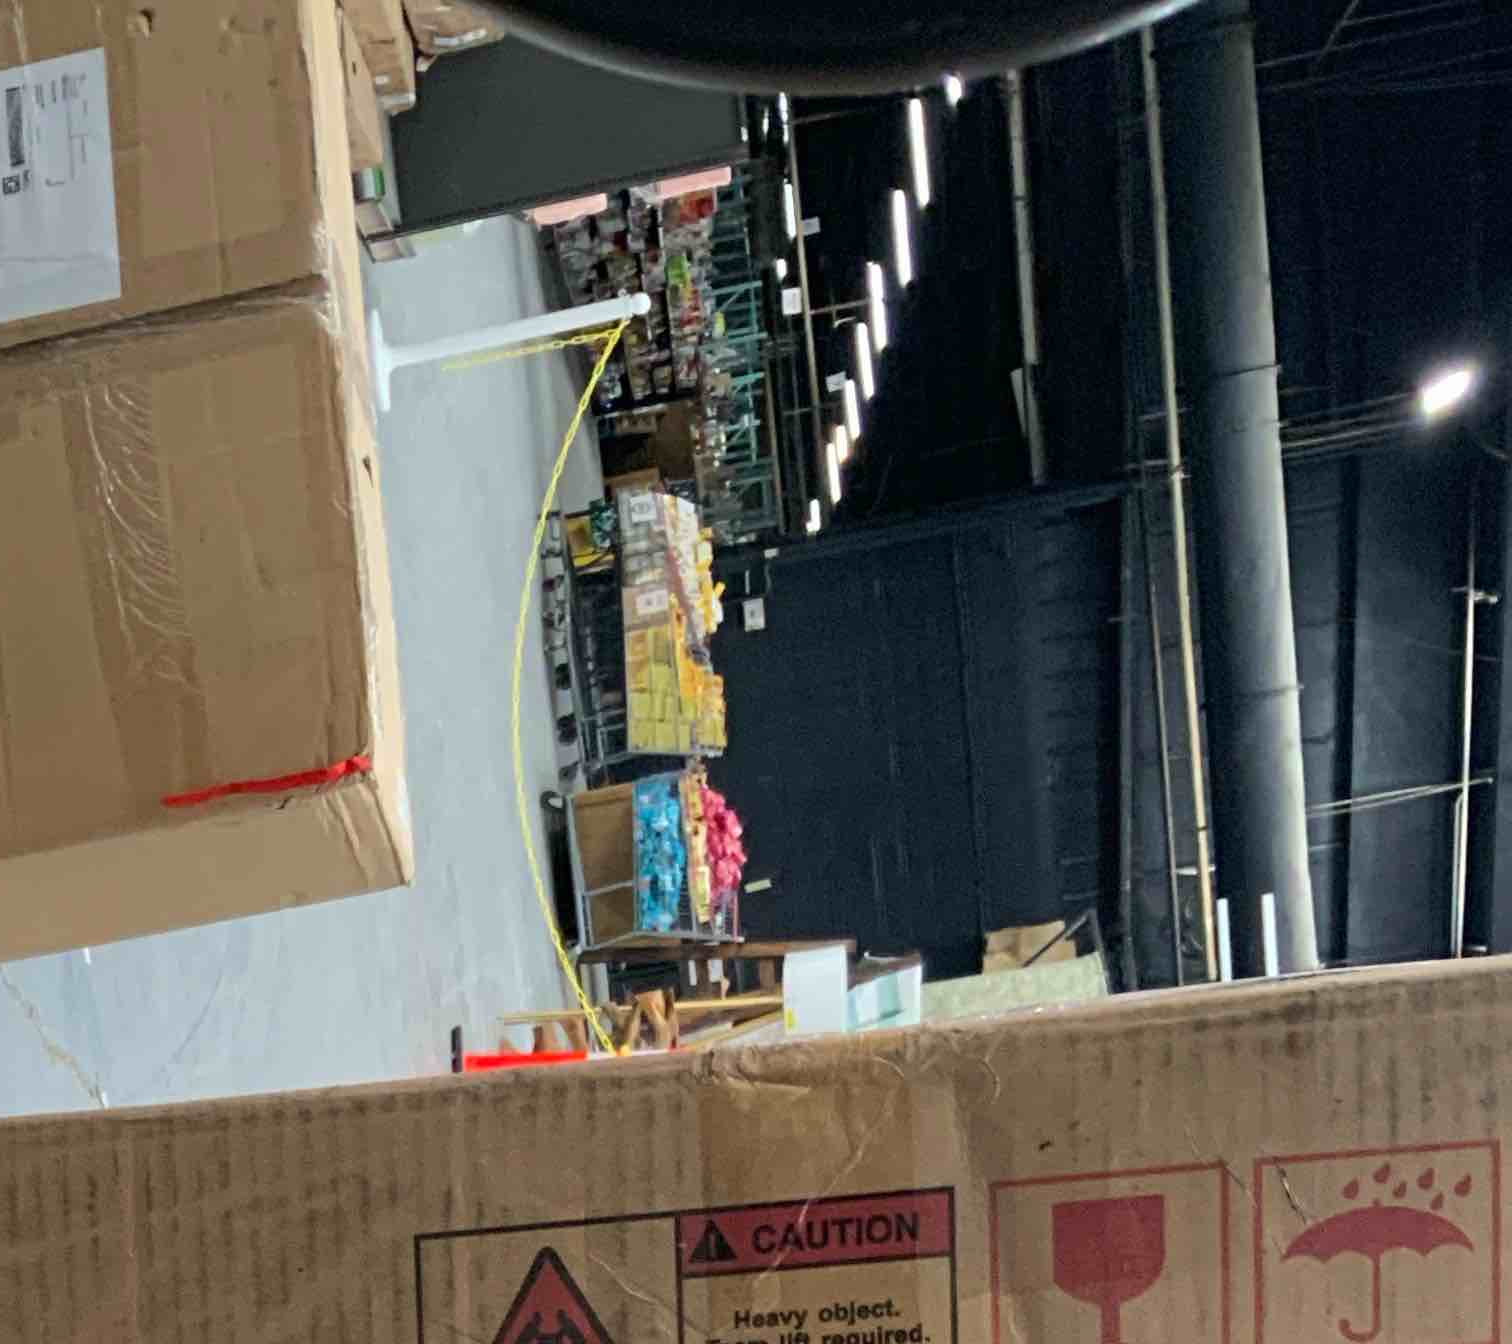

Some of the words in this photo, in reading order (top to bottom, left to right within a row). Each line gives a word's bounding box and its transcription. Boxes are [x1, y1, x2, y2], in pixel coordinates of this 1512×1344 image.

[752, 1213, 920, 1254] CAUTION
[734, 1308, 808, 1330] Heavy
[819, 1300, 901, 1326] object.
